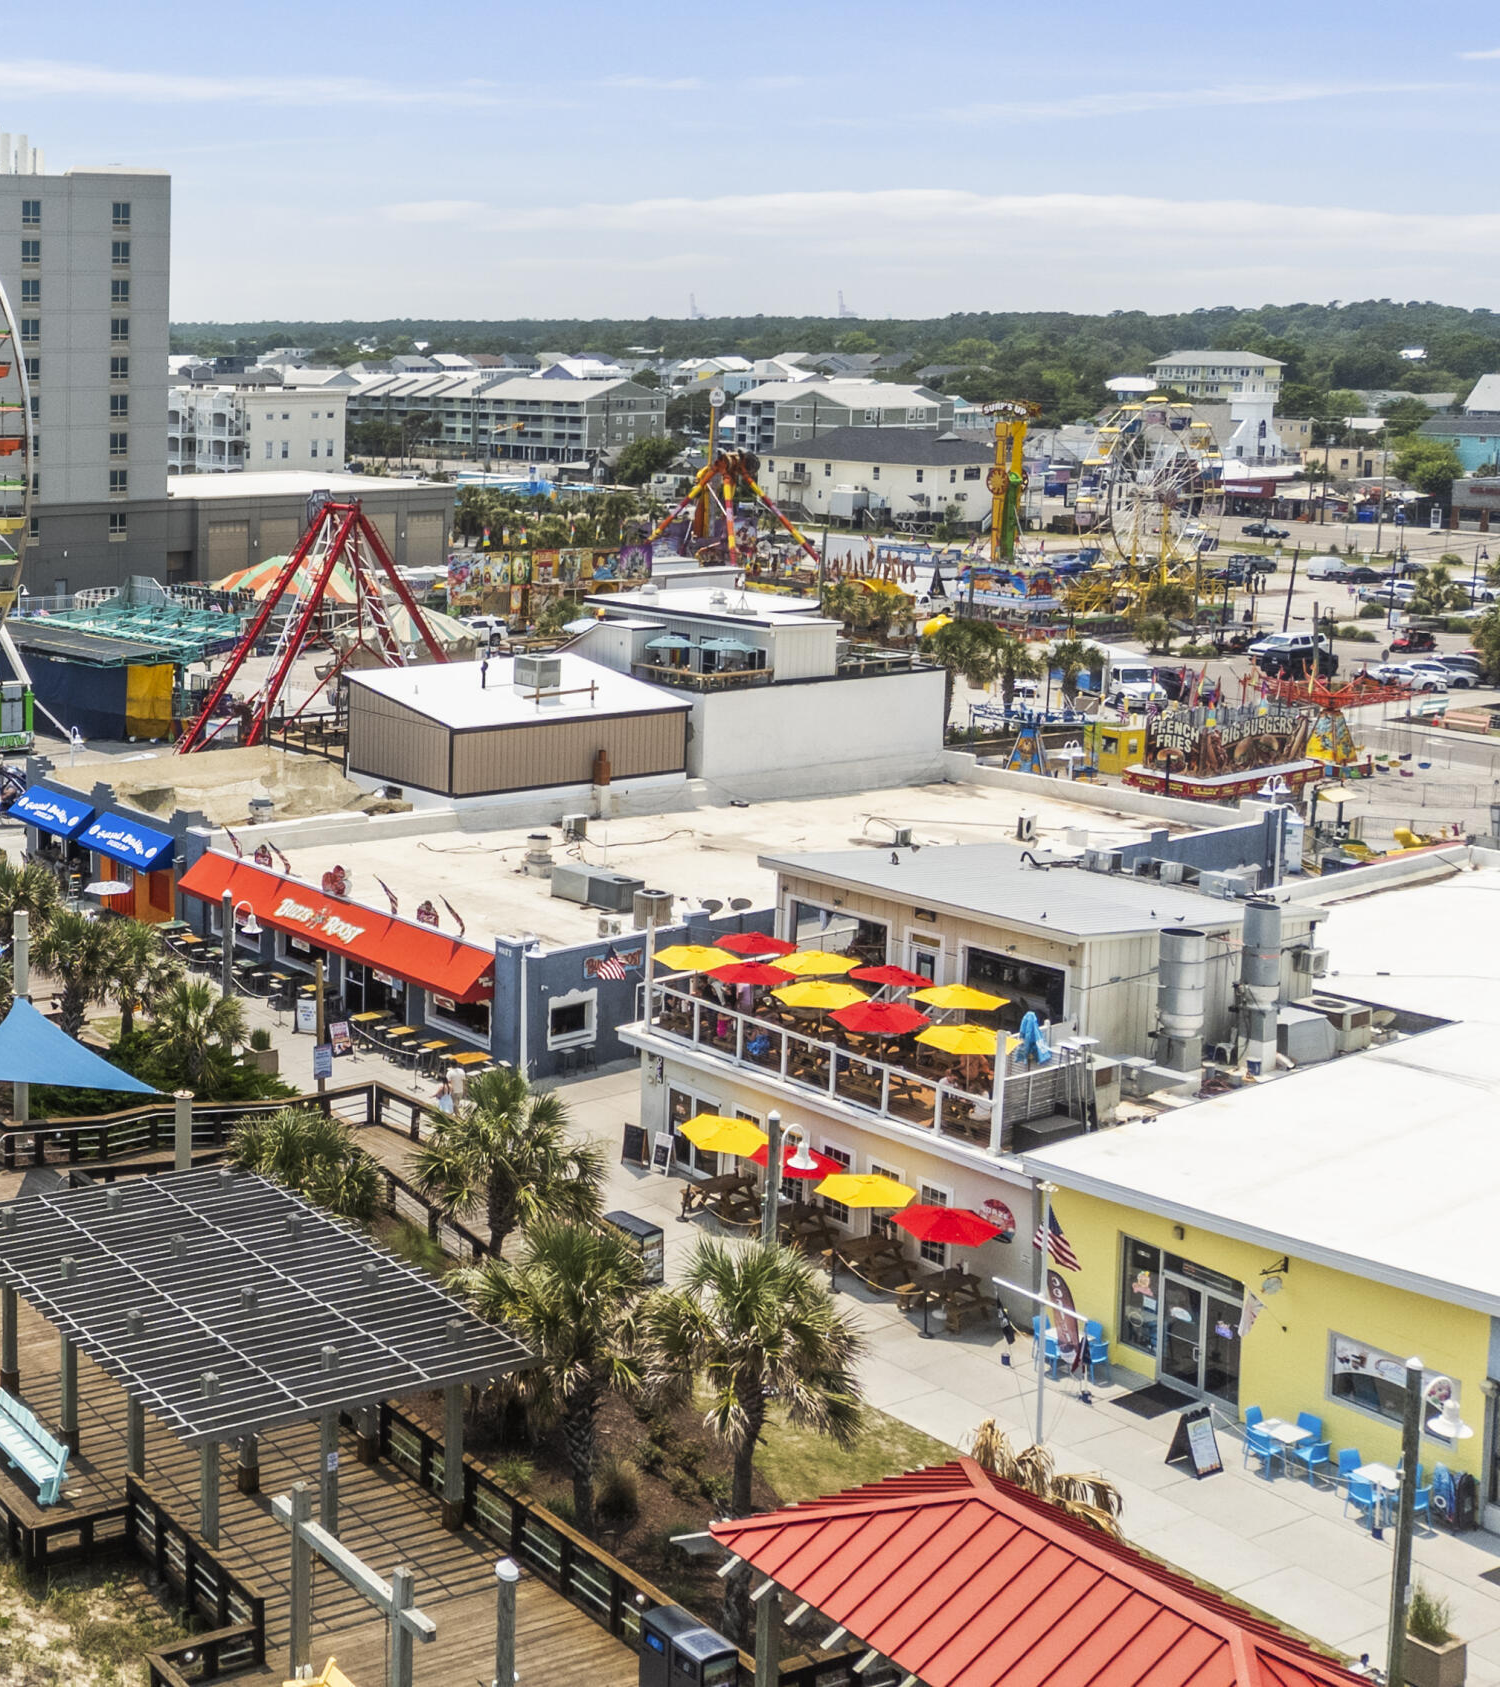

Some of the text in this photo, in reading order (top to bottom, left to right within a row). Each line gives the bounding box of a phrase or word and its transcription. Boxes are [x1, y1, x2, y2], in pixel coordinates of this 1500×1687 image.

[1014, 405, 1027, 415] UP
[1156, 734, 1192, 753] FRIES
[1221, 725, 1240, 746] BIG
